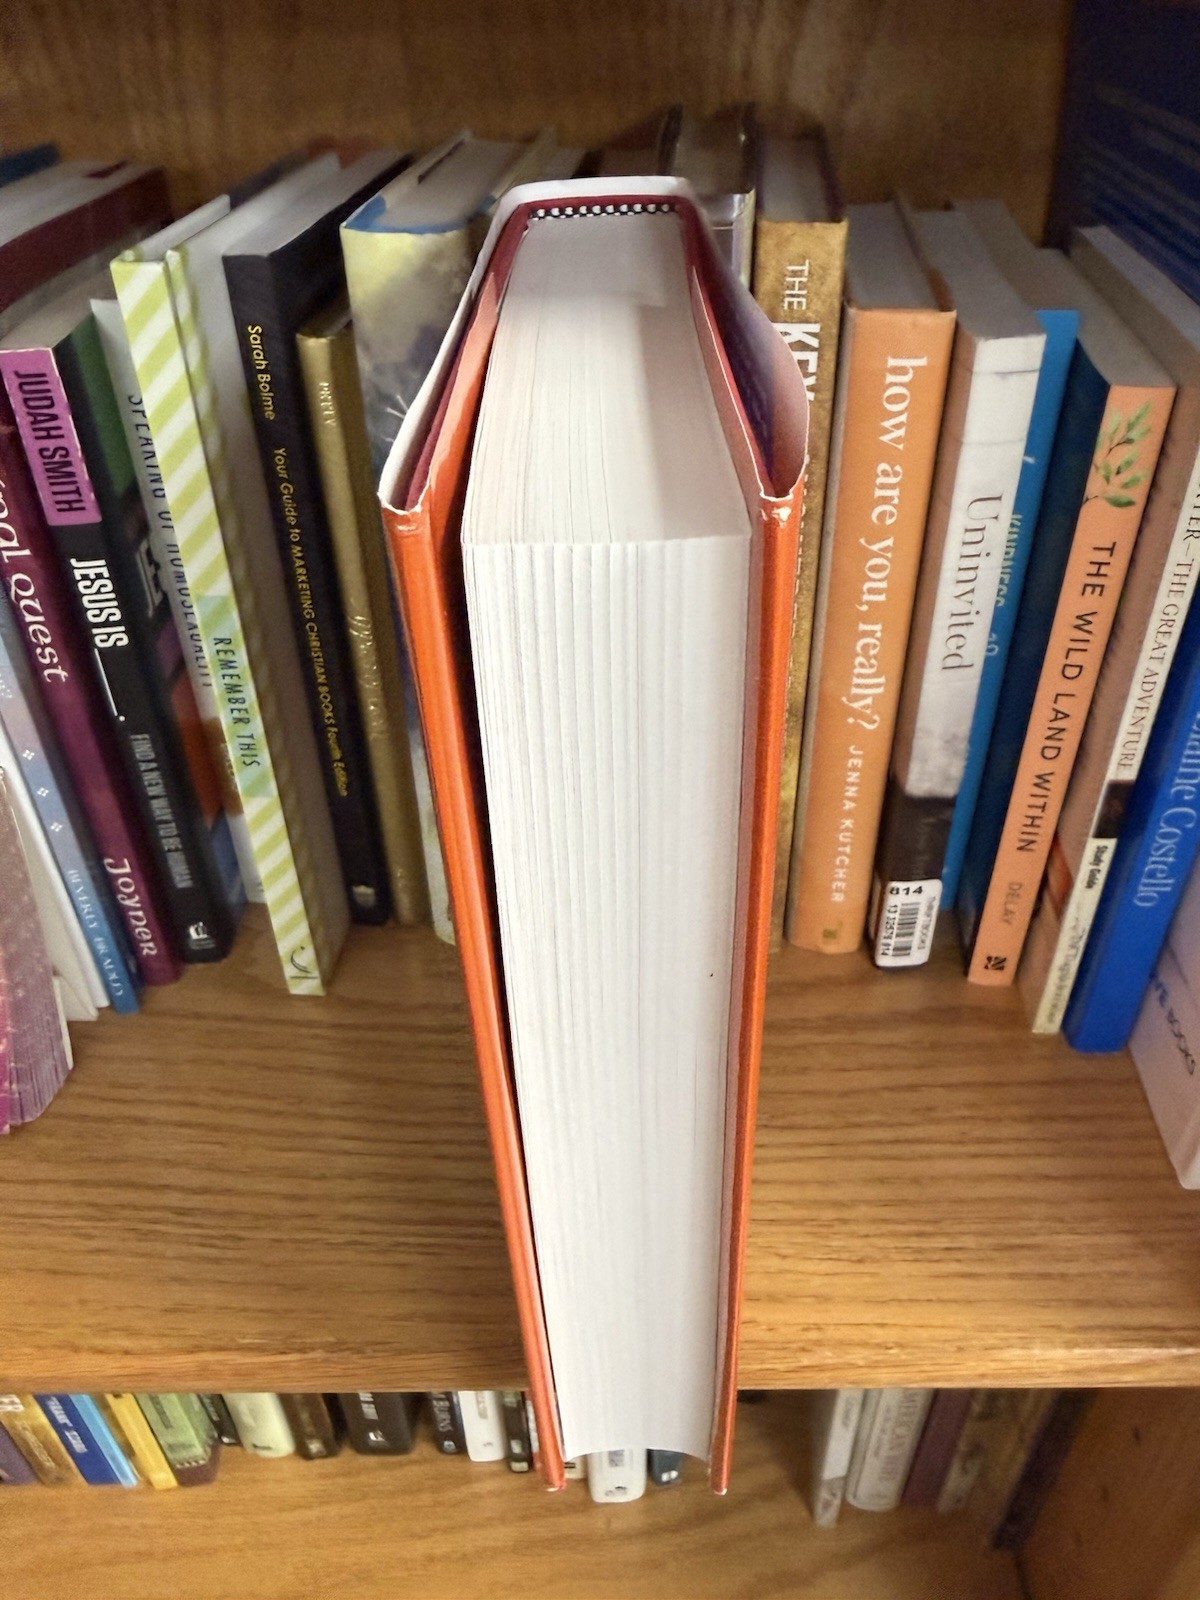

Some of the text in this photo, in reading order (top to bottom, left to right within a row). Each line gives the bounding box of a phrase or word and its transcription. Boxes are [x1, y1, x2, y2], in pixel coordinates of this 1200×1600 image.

[783, 259, 810, 310] THE
[248, 324, 275, 420] Sarah Bolme
[13, 370, 86, 513] JUDAH SMITH
[274, 447, 289, 479] Your
[280, 482, 298, 525] Guide
[289, 528, 300, 542] to
[841, 355, 928, 731] how are you, really?
[70, 558, 130, 649] JESUS IS
[291, 545, 316, 619] MARKETING
[941, 494, 1003, 670] Uninvited
[305, 622, 327, 684] CHRISTIAN
[1150, 602, 1180, 664] GREAT
[213, 636, 250, 725] REMEMBER
[236, 732, 261, 767] THIS
[318, 685, 336, 725] BOOKS
[1016, 541, 1117, 853] THE WILD LAND WITHIN
[1116, 667, 1160, 771] ADVENTURE
[130, 733, 155, 761] FIND
[143, 771, 166, 796] NEW
[151, 797, 174, 823] WAY
[830, 744, 864, 903] JENNA KUTCHER
[1133, 806, 1198, 907] Costello
[889, 886, 923, 895] 814
[1002, 881, 1024, 926] DELAY
